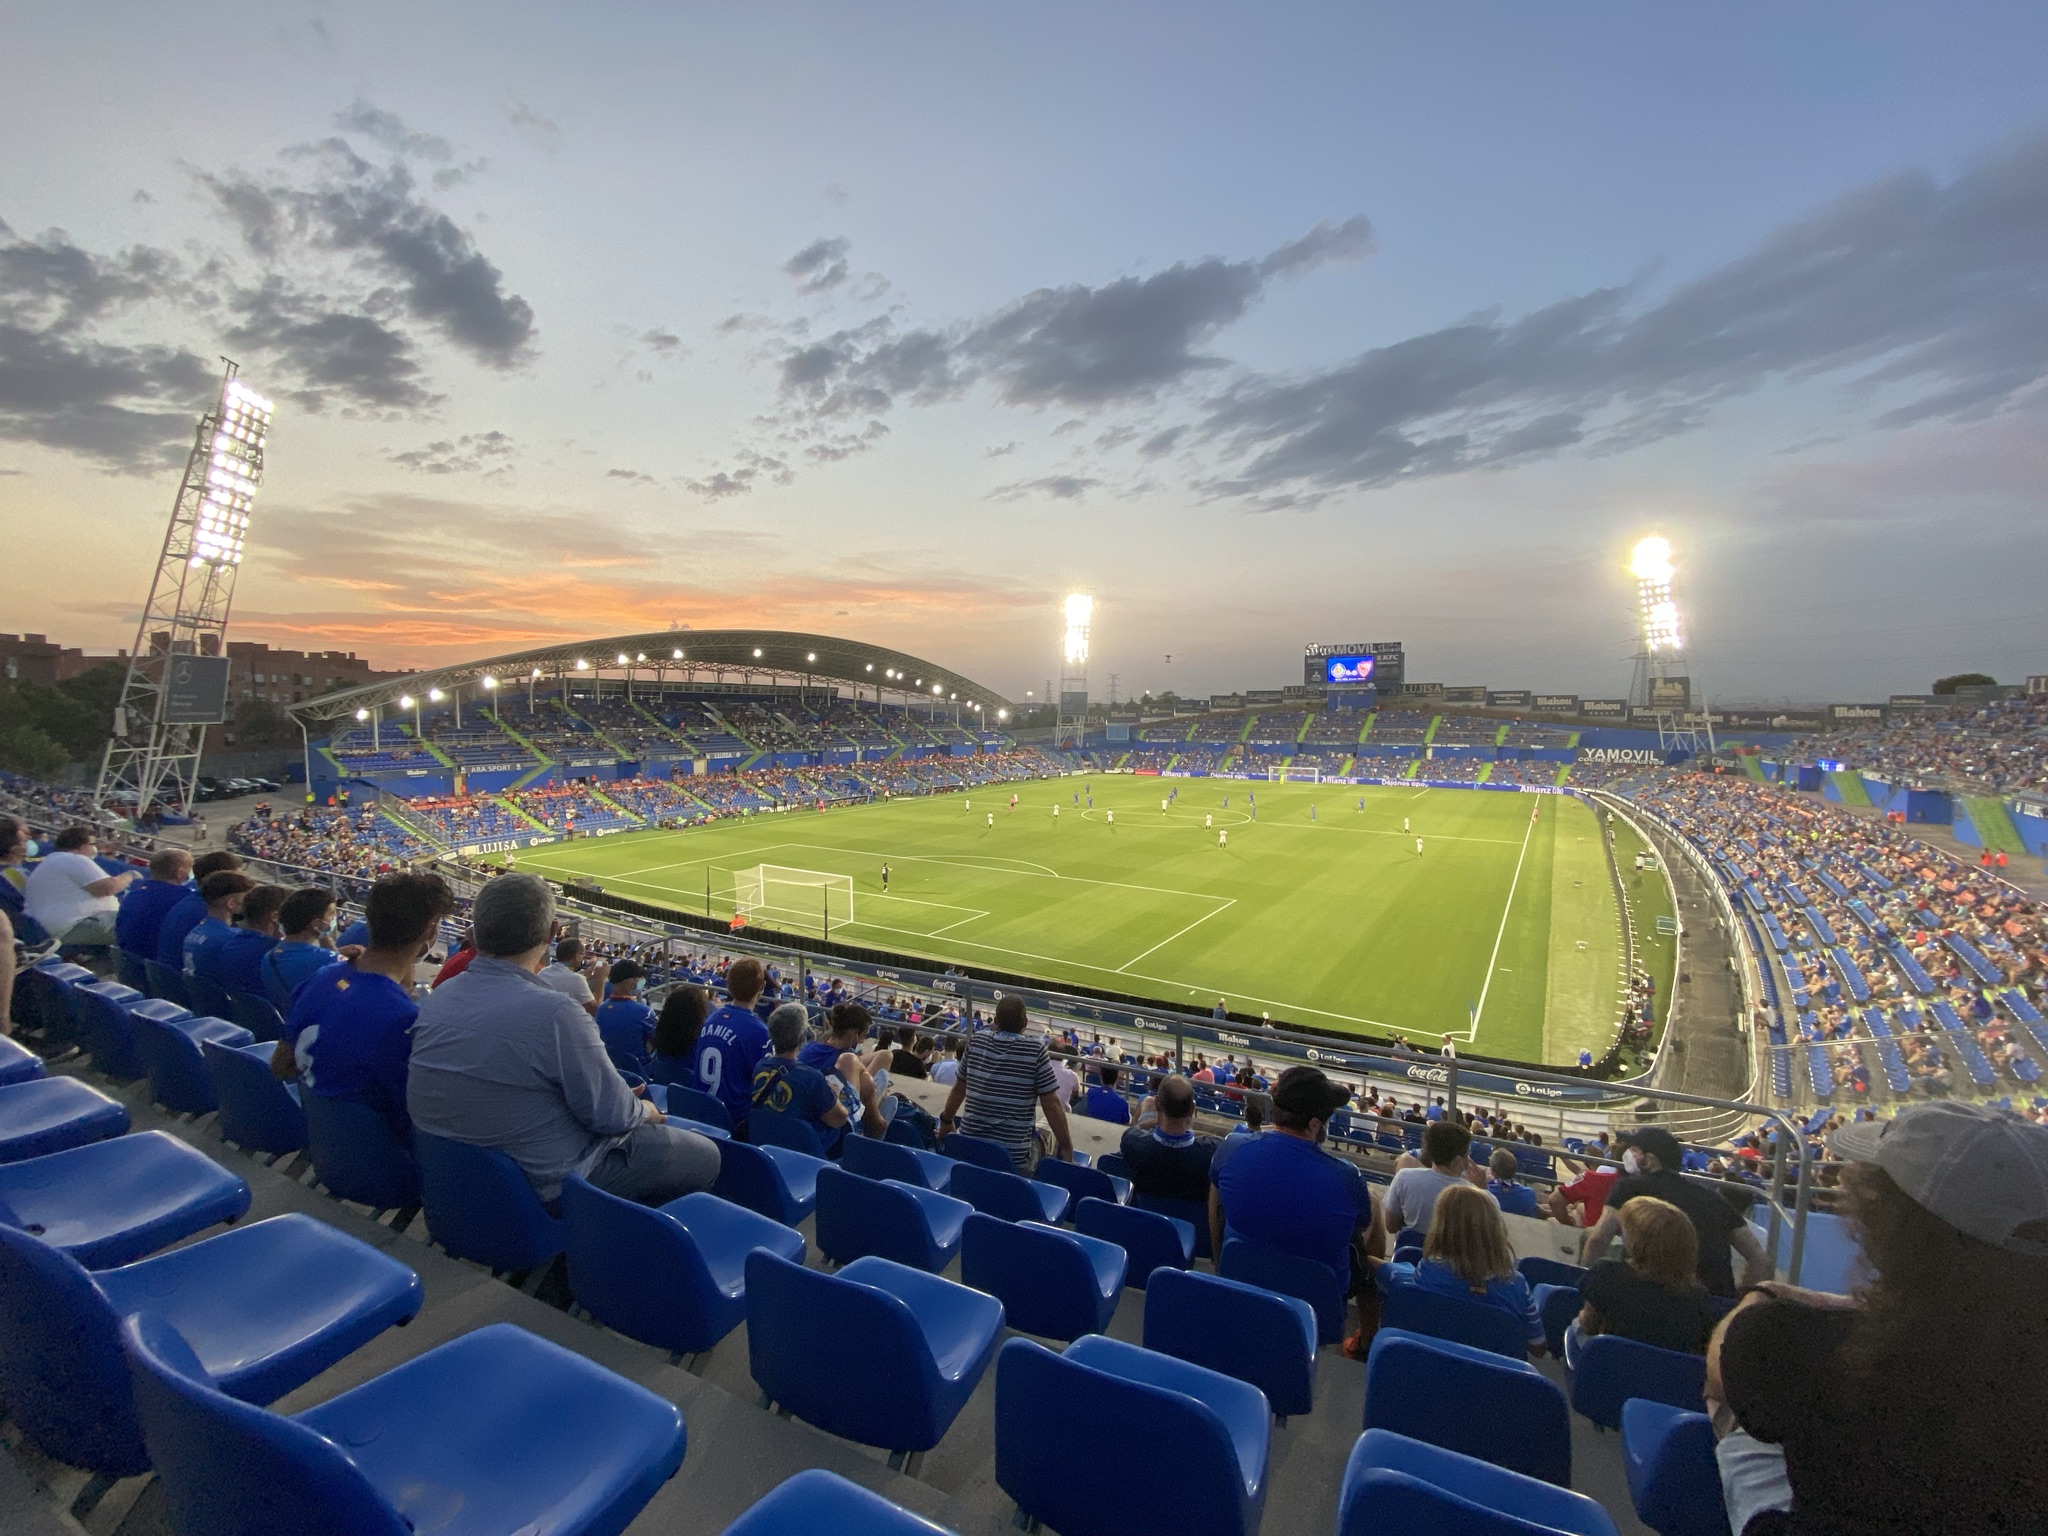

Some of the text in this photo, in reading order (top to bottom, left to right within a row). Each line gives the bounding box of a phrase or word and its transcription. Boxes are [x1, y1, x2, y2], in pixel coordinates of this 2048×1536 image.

[1402, 684, 1442, 694] LUJISA
[1536, 696, 1572, 706] Mahou
[1583, 701, 1621, 711] Mahou
[1834, 706, 1881, 718] Mahou
[1577, 756, 1612, 764] COCHES
[1584, 748, 1659, 761] YAMOVIL
[470, 764, 512, 773] ARA SPORT
[1321, 776, 1347, 785] Allianz
[1519, 785, 1551, 794] Allianz
[475, 840, 519, 855] LUJISA
[1145, 1019, 1168, 1031] LaLiga
[700, 1023, 738, 1047] DANIEL
[1218, 1032, 1250, 1046] Mahou
[1320, 1053, 1347, 1064] LaLiga
[701, 1047, 722, 1097] 9
[1531, 1087, 1563, 1098] LaLiga
